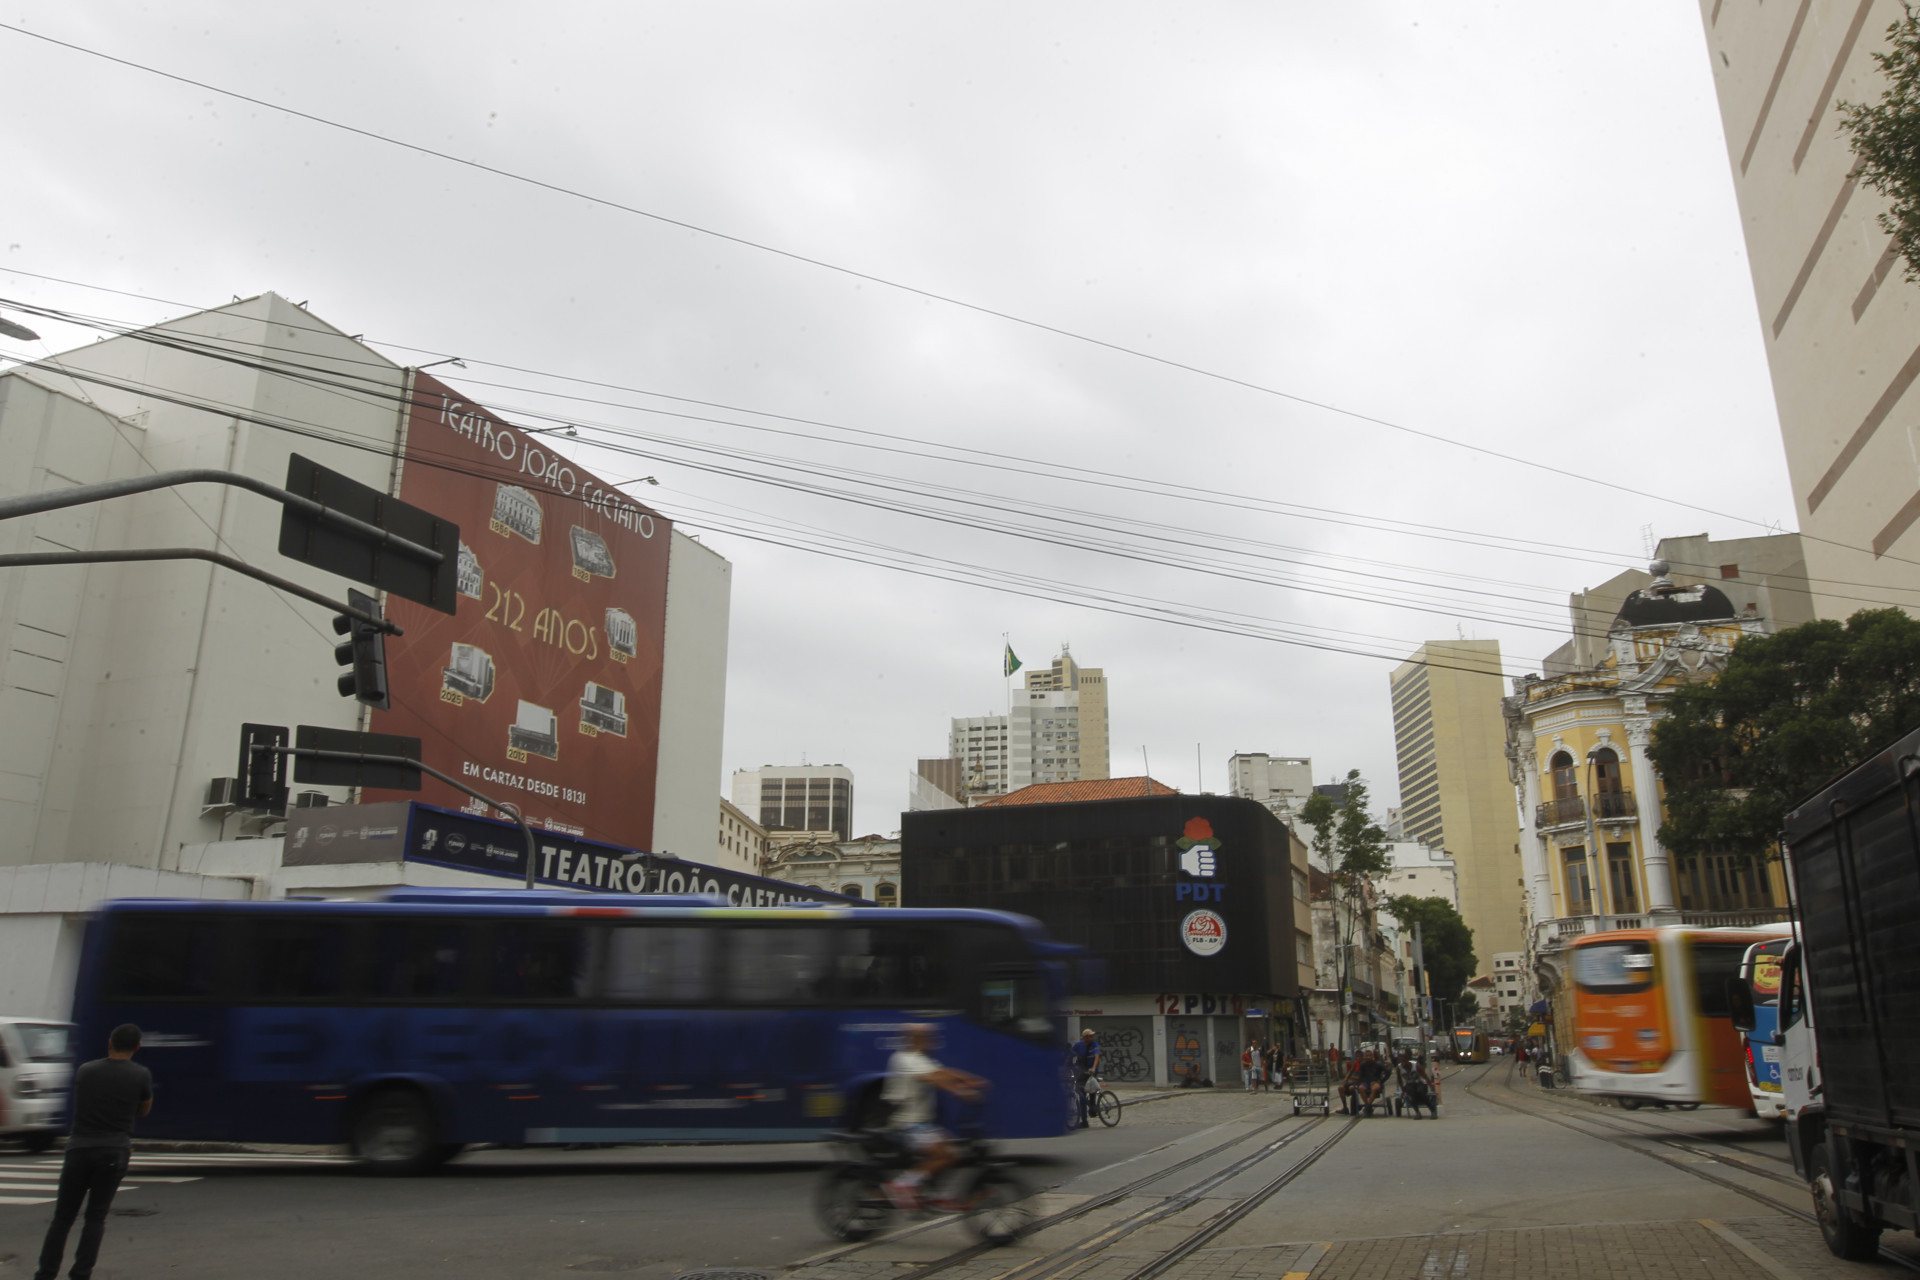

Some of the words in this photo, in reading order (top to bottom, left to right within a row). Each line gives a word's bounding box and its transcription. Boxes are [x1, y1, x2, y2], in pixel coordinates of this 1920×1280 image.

[440, 394, 516, 460] TEATRO
[519, 443, 576, 495] JOÃO
[582, 481, 654, 539] CAETANO
[573, 566, 590, 582] 1928
[485, 581, 525, 632] 212
[533, 608, 598, 661] ANOS
[441, 689, 462, 705] 2025
[508, 748, 526, 762] 2012
[463, 762, 480, 777] EM
[483, 767, 525, 788] CARTAZ
[527, 777, 560, 798] DESDE
[561, 787, 587, 806] 1813!
[541, 846, 646, 894] TEATRO
[655, 868, 719, 893] JOÃO
[1176, 883, 1225, 901] PDT
[1155, 992, 1180, 1015] 12
[1184, 992, 1228, 1015] PDT
